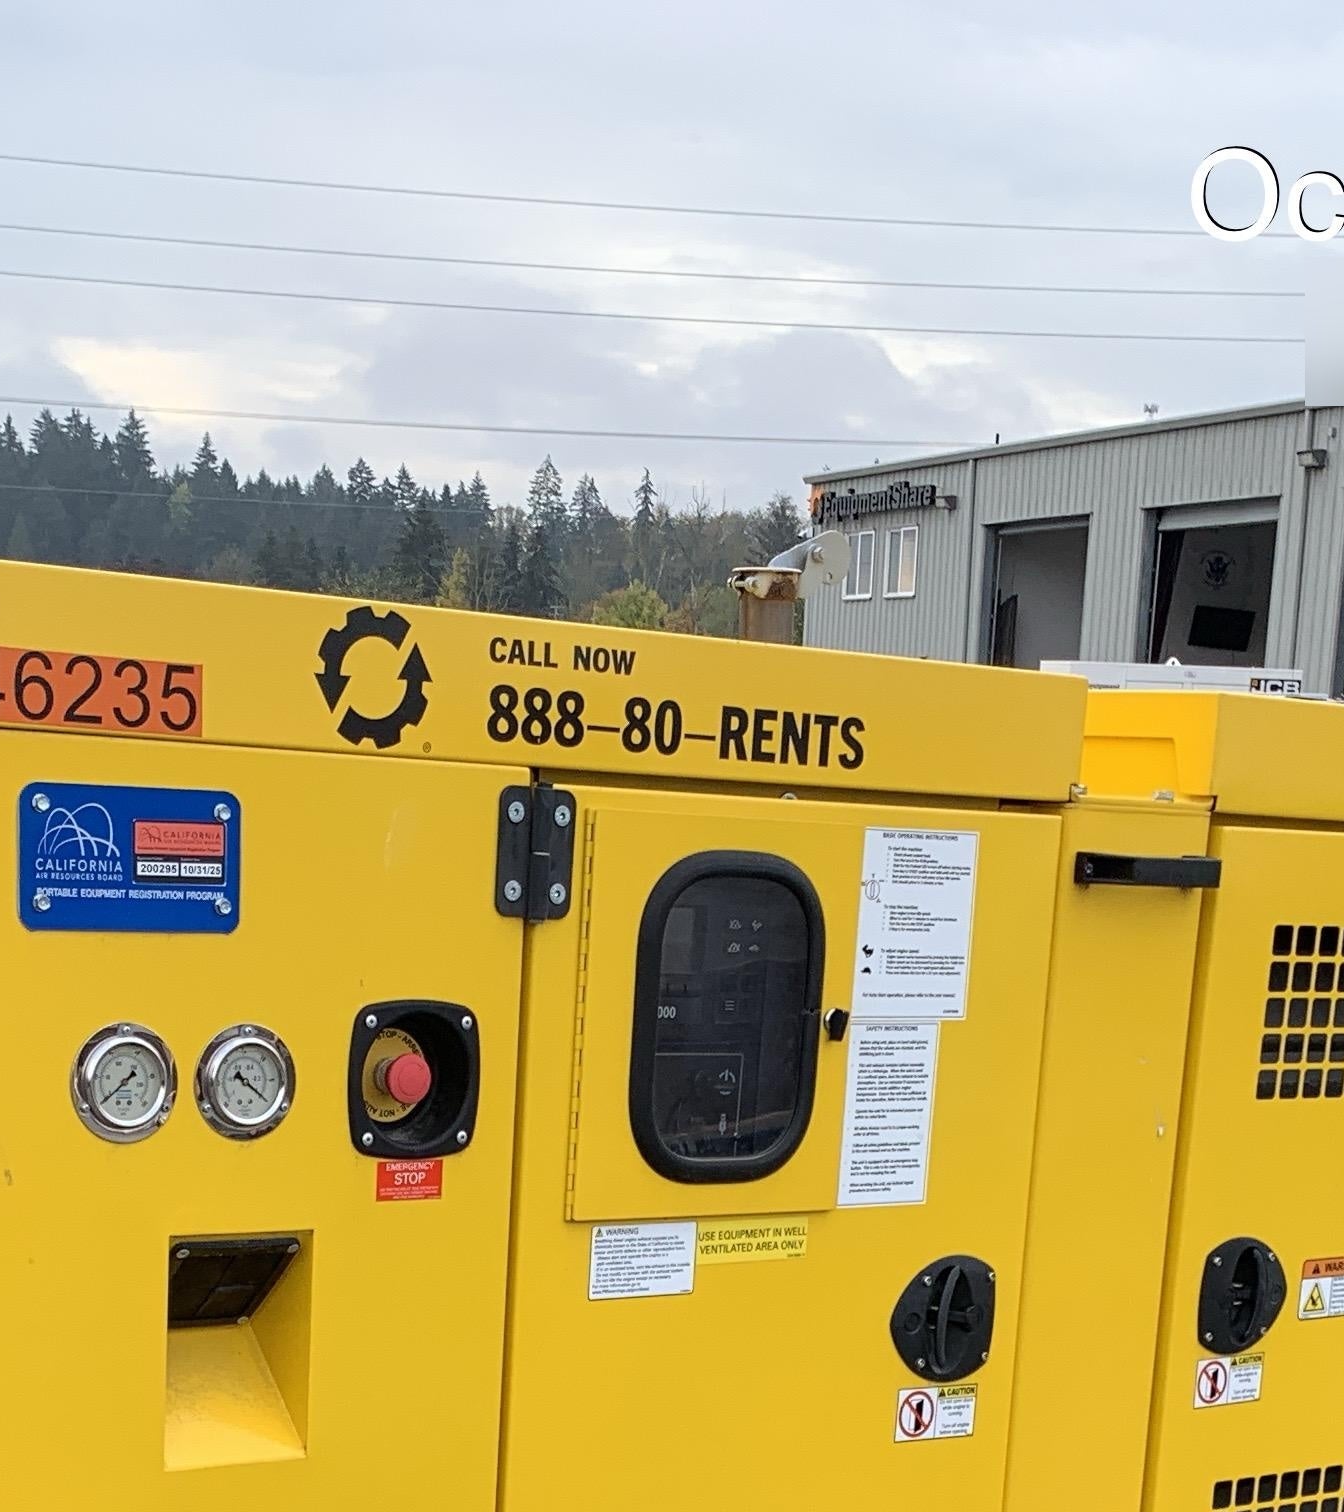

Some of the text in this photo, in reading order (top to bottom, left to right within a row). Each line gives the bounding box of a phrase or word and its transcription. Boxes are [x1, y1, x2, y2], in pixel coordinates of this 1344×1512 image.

[824, 481, 937, 522] EquipmentShare
[489, 636, 637, 676] CALL NOW
[1251, 679, 1300, 695] JCB
[35, 857, 123, 873] CALIFORNIA
[140, 863, 177, 873] 200295
[183, 865, 221, 875] 10/31/25
[51, 873, 94, 881] RESOURCES
[97, 873, 123, 882] BOARD
[36, 887, 224, 901] PORTABLE EQUIPMENT REGISTRATION PROGRAM
[386, 1161, 435, 1171] EMERGENCY
[394, 1171, 426, 1186] STOP
[698, 1226, 807, 1241] USE EQUIPMENT IN WELL
[699, 1239, 805, 1255] VENTILATED AREA ONLY
[947, 1387, 975, 1396] CAUTION
